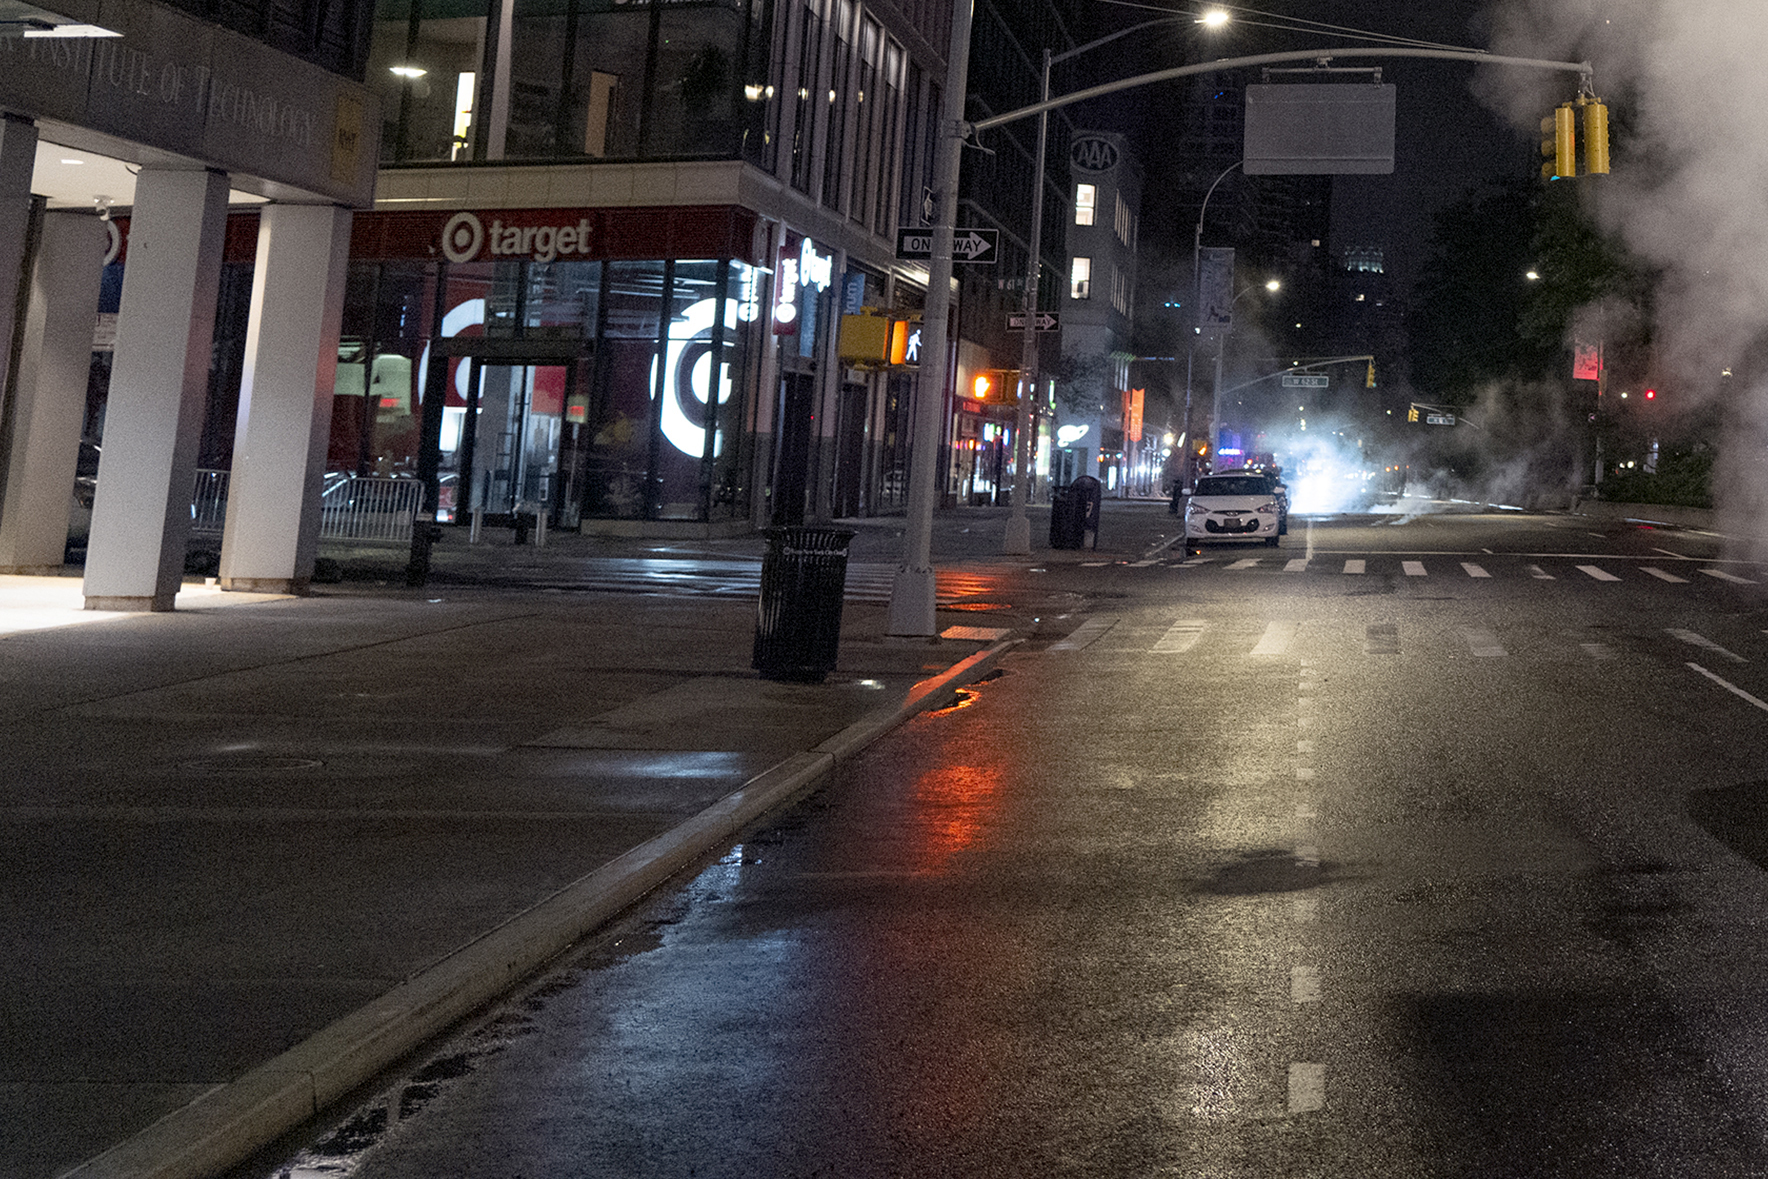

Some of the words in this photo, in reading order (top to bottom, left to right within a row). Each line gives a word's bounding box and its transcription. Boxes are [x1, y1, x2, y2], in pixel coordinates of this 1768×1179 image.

[160, 62, 184, 104] OF
[1076, 141, 1112, 169] AAA
[490, 219, 593, 263] target
[910, 238, 931, 251] ON
